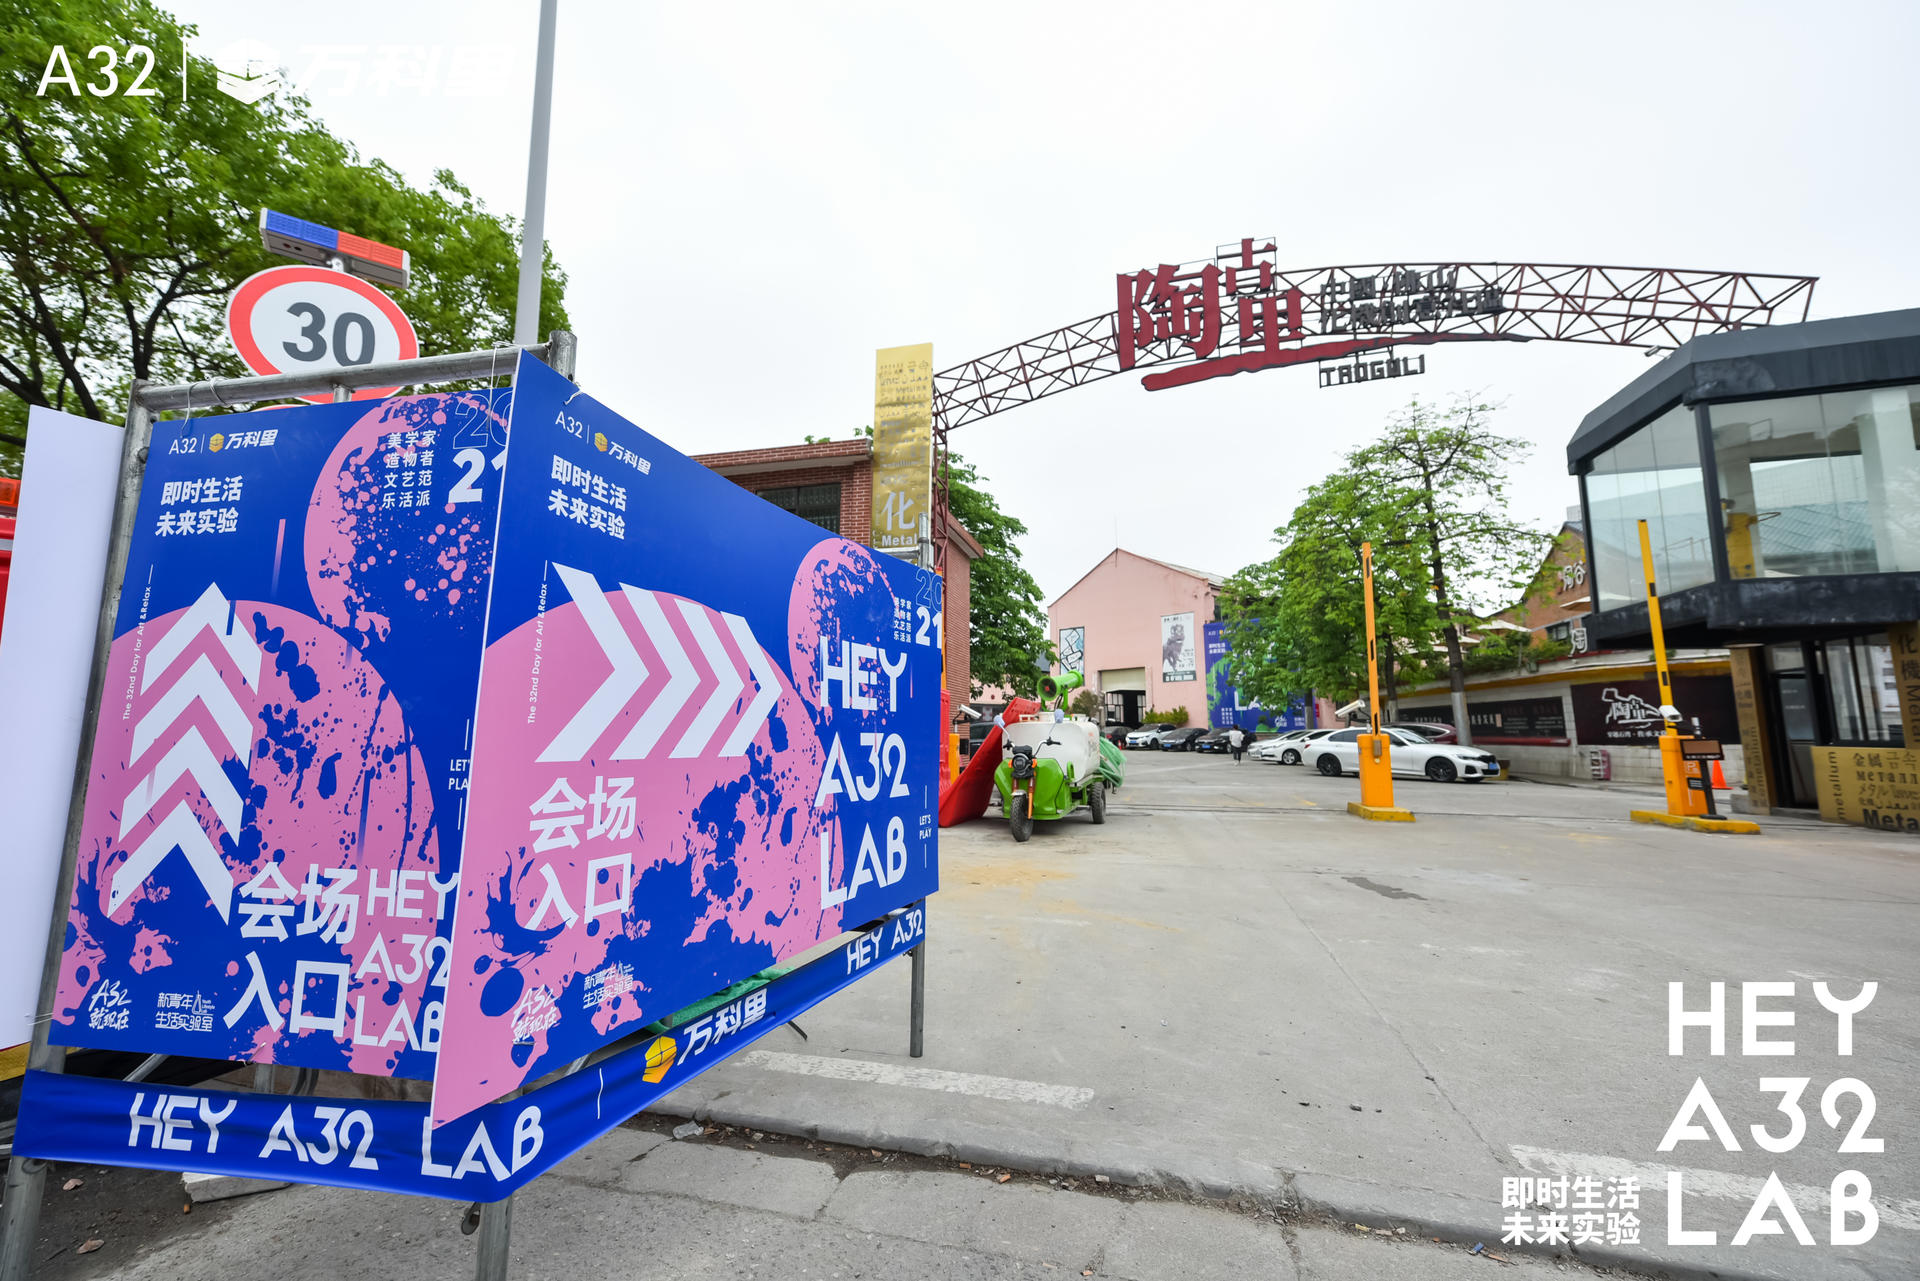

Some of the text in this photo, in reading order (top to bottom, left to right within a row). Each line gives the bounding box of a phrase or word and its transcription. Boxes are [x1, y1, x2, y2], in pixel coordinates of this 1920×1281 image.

[282, 301, 376, 367] 30
[1320, 354, 1424, 388] TAOGULI
[225, 429, 278, 450] 万科里
[388, 430, 436, 448] 美学家
[555, 411, 583, 439] A32
[168, 437, 198, 455] A32
[385, 450, 434, 469] 造物者
[608, 441, 652, 475] 万科里
[161, 475, 244, 506] 即时生活
[383, 470, 432, 489] 文艺范
[448, 448, 507, 503] 2
[551, 454, 627, 512] 即时生活
[381, 490, 431, 509] 乐活派
[548, 488, 625, 540] 未来实验
[881, 491, 915, 531] 化
[155, 507, 239, 537] 未来实验
[881, 533, 917, 547] Metal
[137, 622, 145, 636] Art
[536, 621, 545, 635] Art
[916, 606, 943, 649] 21
[134, 638, 142, 652] for
[534, 638, 543, 652] for
[130, 654, 140, 673] Day
[532, 654, 542, 674] Day
[820, 635, 907, 713] HEY
[127, 676, 136, 700] 32nd
[529, 677, 539, 702] 32nd
[123, 703, 132, 720] The
[527, 706, 536, 724] The
[450, 759, 470, 772] LET'
[814, 731, 910, 807] A32
[448, 777, 469, 790] PLA
[528, 776, 637, 854] 会场
[919, 827, 932, 839] PLAY
[820, 816, 908, 910] LAB
[238, 862, 360, 944] 会场
[366, 868, 460, 920] HEY
[524, 852, 633, 931] 入口
[847, 909, 924, 975] HEY A32
[355, 931, 451, 987] A32
[582, 977, 634, 1009] 生活实验室
[584, 965, 616, 991] 新青年
[88, 979, 132, 1012] A32
[157, 992, 194, 1010] 新青年
[223, 951, 350, 1038] 入口
[511, 984, 559, 1029] A32
[89, 1007, 130, 1031] 就现在
[155, 1011, 213, 1032] 生活实验室
[353, 995, 444, 1053] LAB
[512, 1006, 557, 1044] 就现在
[677, 988, 767, 1066] 万科里
[129, 1093, 544, 1181] HEY A32 LAB
